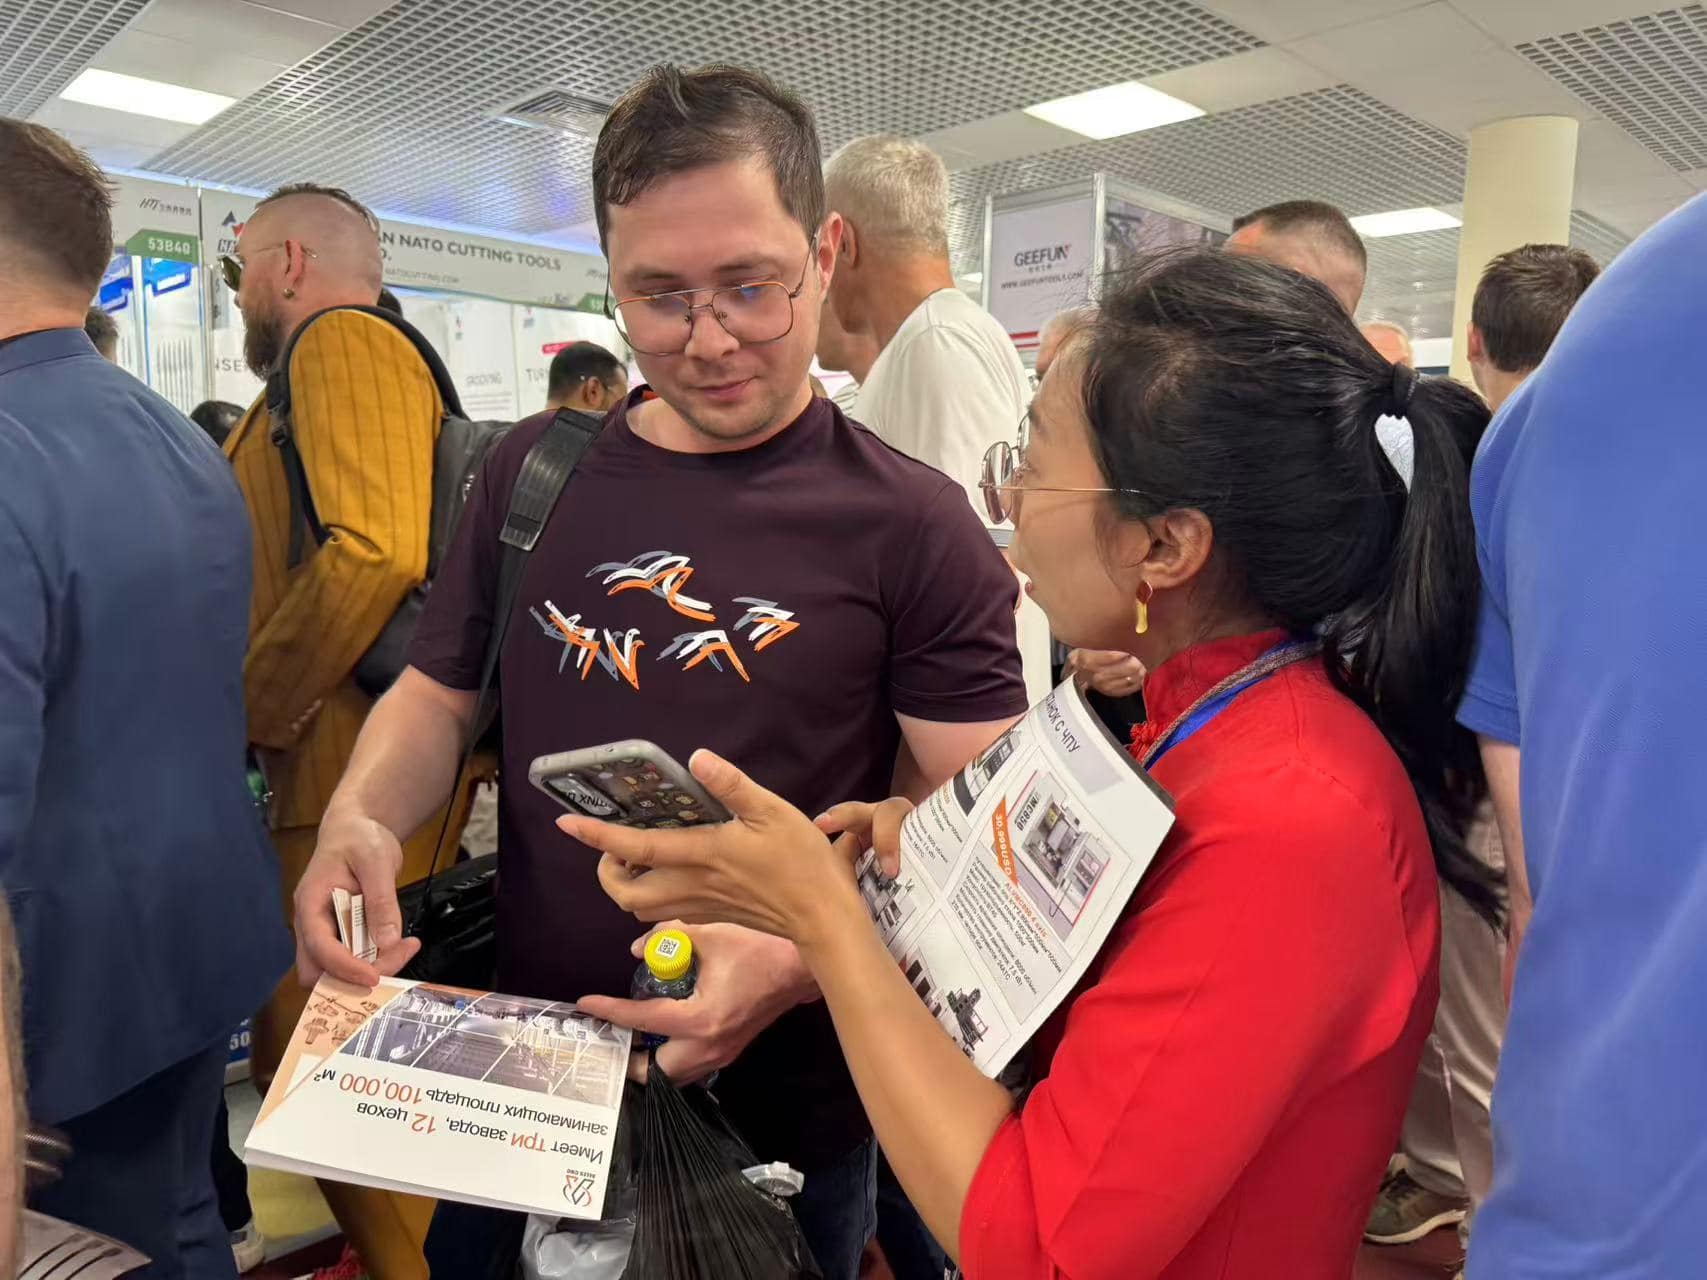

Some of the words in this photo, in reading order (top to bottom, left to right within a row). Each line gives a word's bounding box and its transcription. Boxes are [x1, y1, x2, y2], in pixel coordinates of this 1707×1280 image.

[399, 234, 443, 252] NATO
[447, 241, 513, 264] CUTTING
[517, 252, 562, 272] TOOLS
[1056, 727, 1081, 754] ЧПУ
[339, 1073, 422, 1104] 100,000
[357, 1103, 408, 1121] цехов
[426, 1089, 500, 1113] площадь
[411, 1113, 437, 1134] 12
[446, 1117, 508, 1140] завода,
[504, 1105, 608, 1135] занимающих
[510, 1133, 547, 1152] три
[550, 1141, 603, 1164] Имеет
